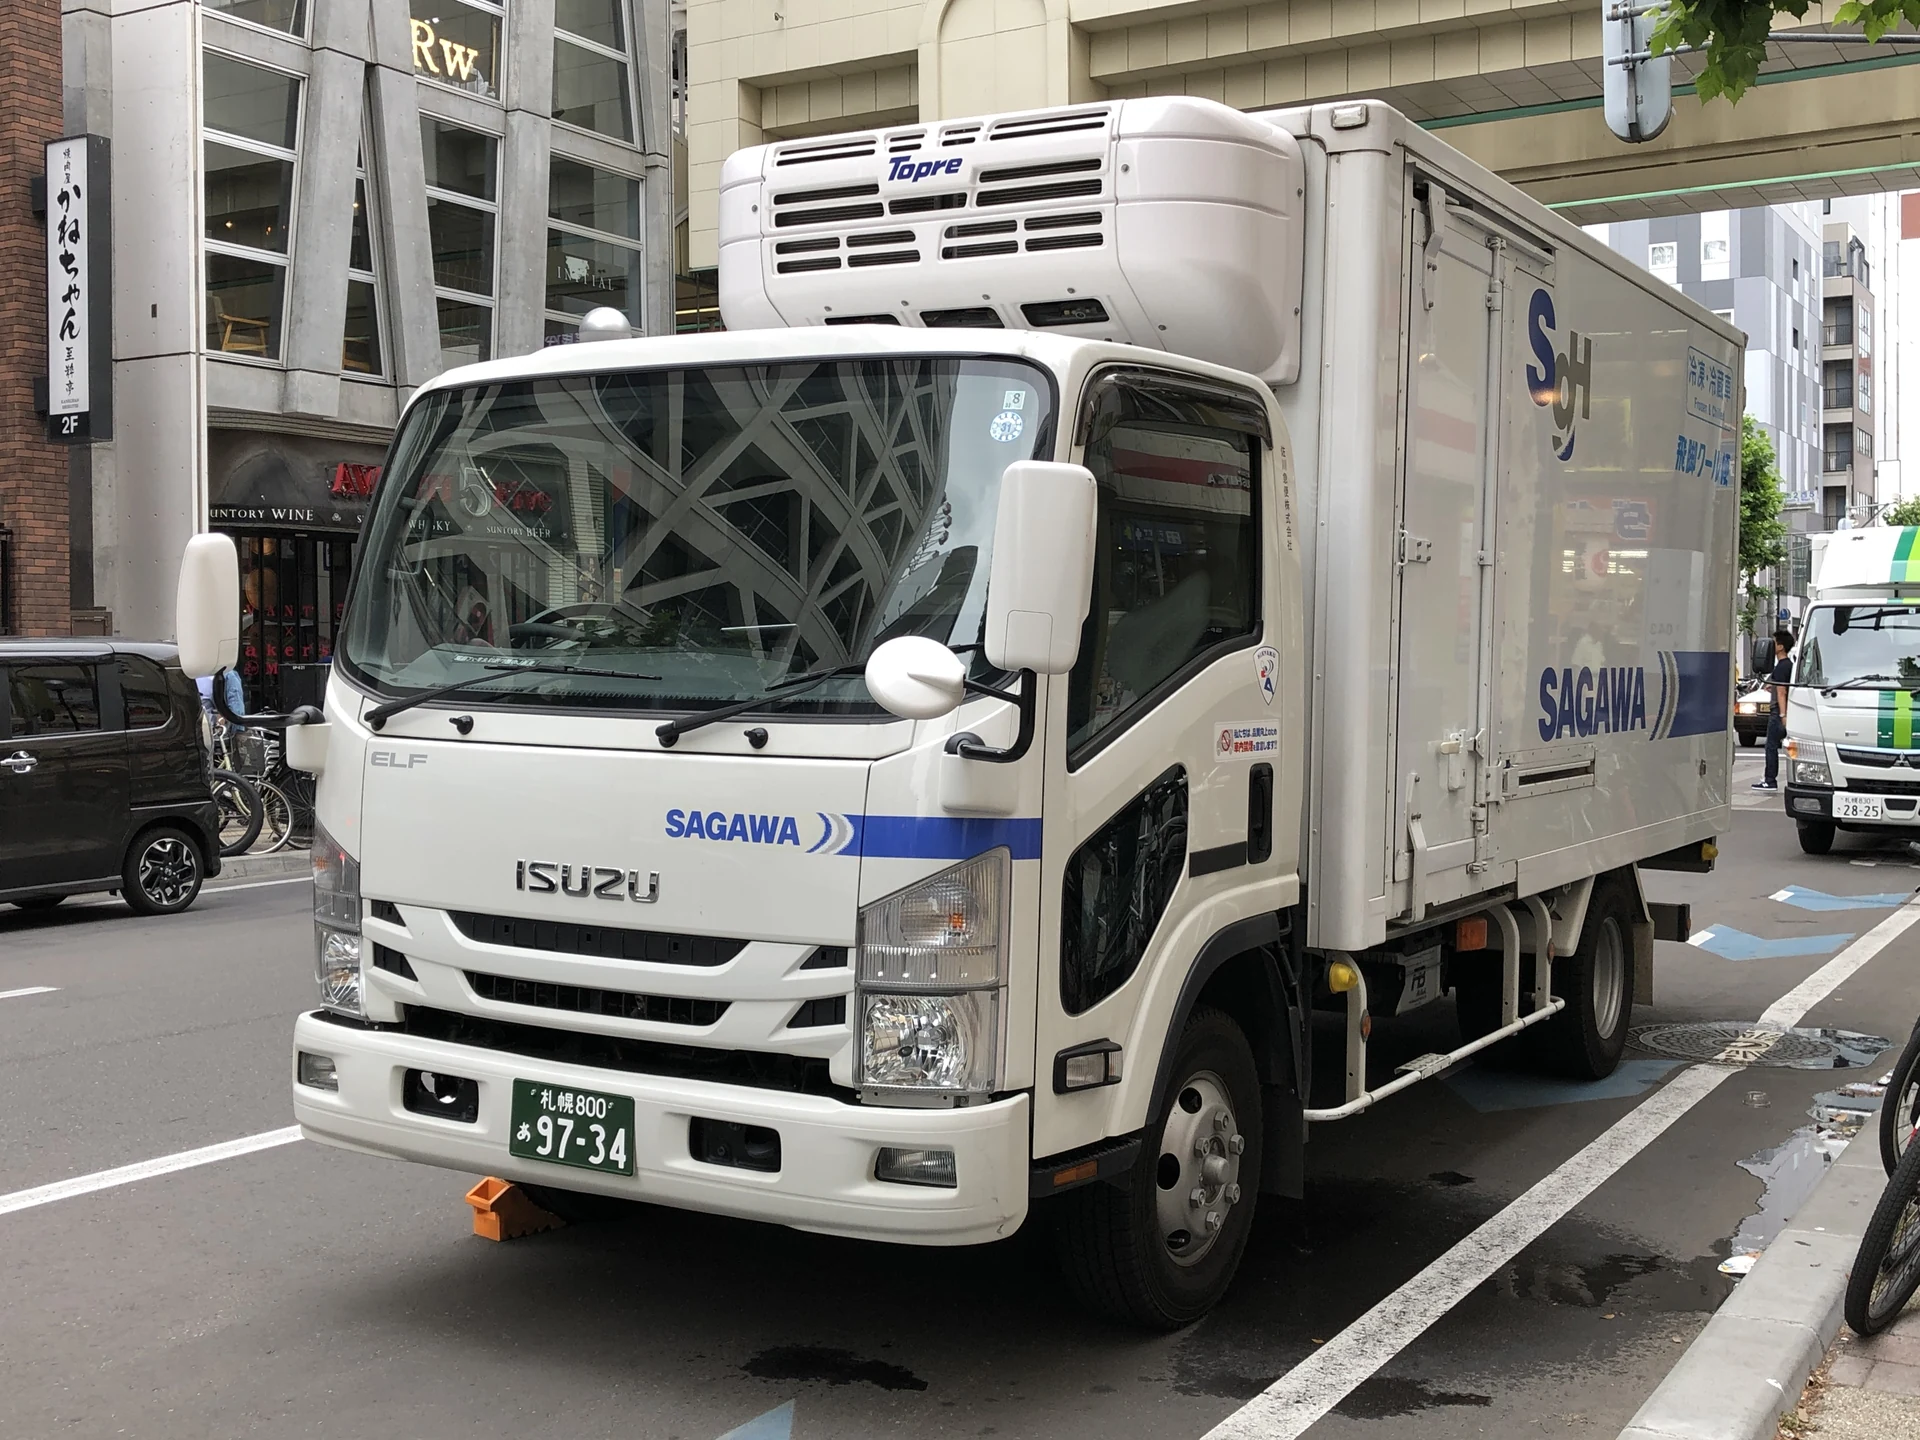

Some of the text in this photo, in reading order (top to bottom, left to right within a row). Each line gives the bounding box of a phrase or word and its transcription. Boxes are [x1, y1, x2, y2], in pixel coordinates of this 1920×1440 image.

[888, 155, 964, 183] Topre
[57, 184, 81, 341] かねちゃん
[557, 266, 614, 291] INTIAL
[1012, 392, 1020, 404] 8
[62, 415, 79, 434] 2F
[1000, 422, 1012, 433] 31
[1675, 434, 1731, 487] 飛脚クール便
[209, 508, 314, 521] UNTORY WINE
[408, 519, 451, 532] WHSKY
[1538, 666, 1647, 742] SAGAWA
[371, 751, 428, 769] ELF
[1843, 804, 1879, 817] 28-25
[665, 808, 800, 846] SAGAWA
[515, 858, 661, 904] ISUZU
[540, 1089, 606, 1119] 札幌800
[516, 1115, 627, 1169] あ 97-34
